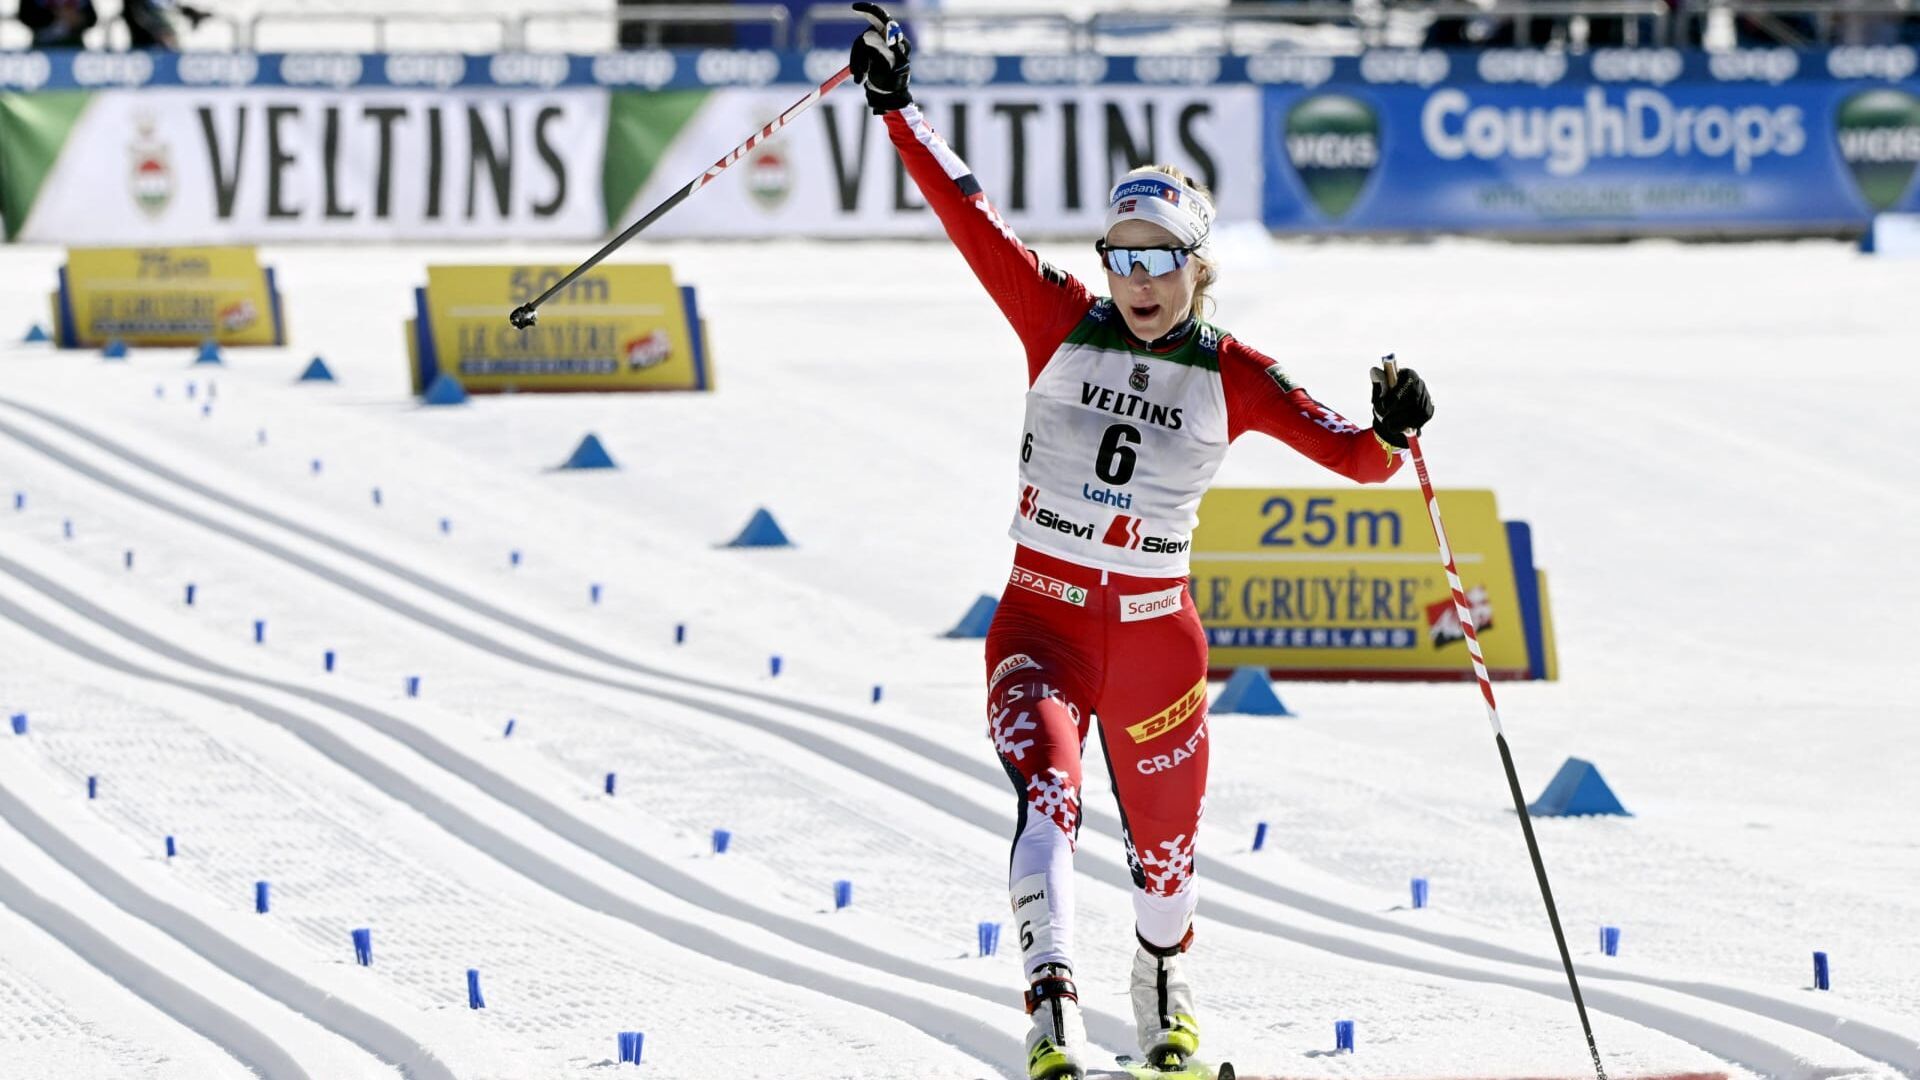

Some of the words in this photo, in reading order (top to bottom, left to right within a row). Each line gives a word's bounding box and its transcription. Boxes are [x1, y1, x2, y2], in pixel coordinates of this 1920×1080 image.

[1421, 88, 1805, 174] CoughDrops
[198, 105, 567, 220] VELTINS
[819, 102, 1217, 213] VTINS
[509, 268, 609, 304] 50m
[1079, 381, 1184, 431] VELTINS
[1021, 432, 1034, 464] 6
[1095, 423, 1142, 486] 6
[1083, 483, 1133, 510] Lahti
[1035, 507, 1095, 541] Sievi
[1260, 496, 1403, 547] 25m
[1141, 535, 1189, 554] Sievi
[1011, 569, 1063, 596] SPAR
[1241, 569, 1420, 621] GRUYÈRE
[1128, 595, 1177, 615] Scandic
[1206, 629, 1411, 647] WITZERLAND
[1142, 690, 1202, 735] DHL
[1136, 722, 1206, 775] CRAFT
[1018, 890, 1045, 910] Sievi
[1019, 919, 1035, 953] 6
